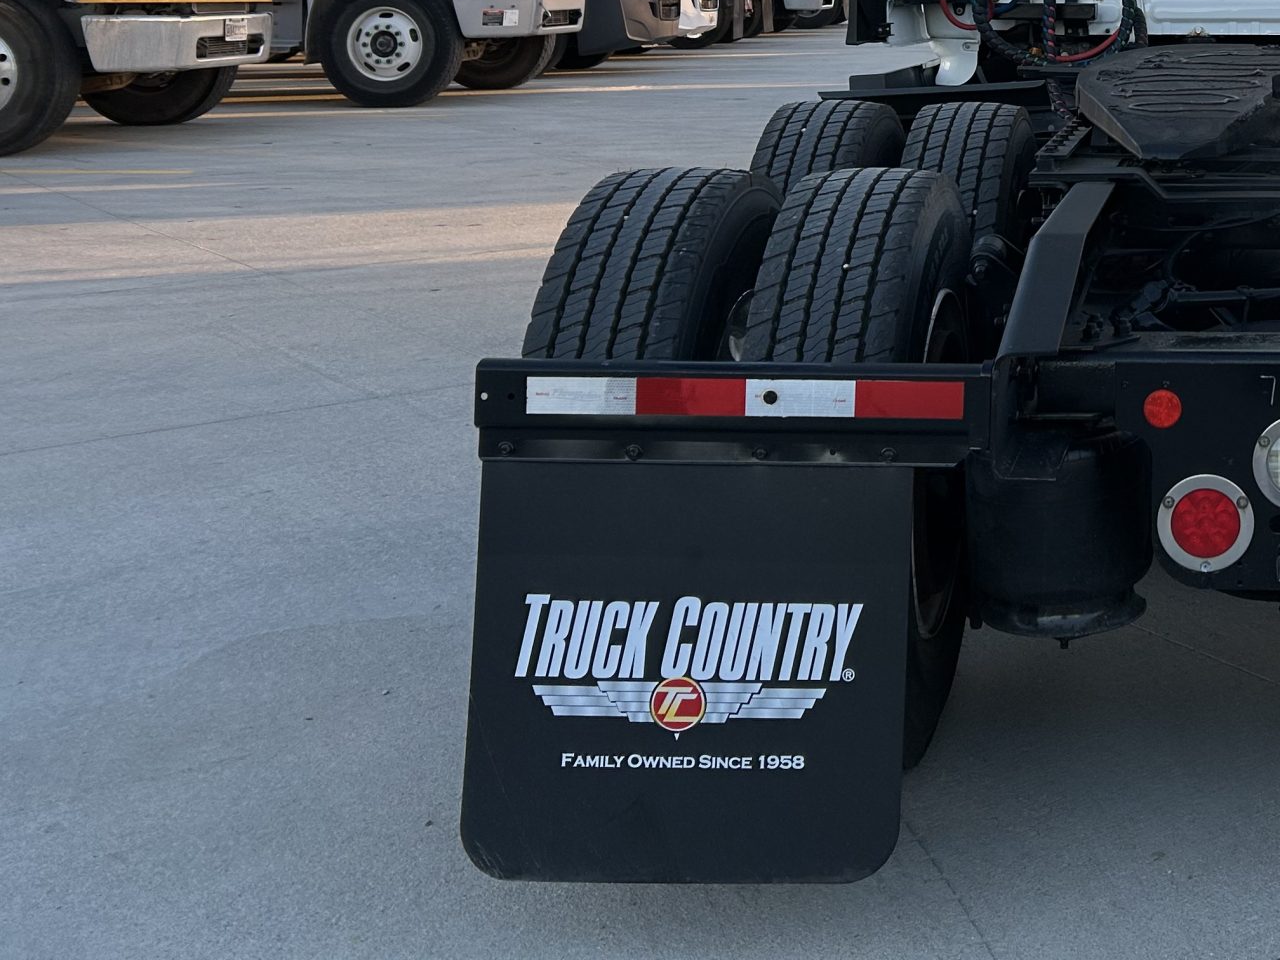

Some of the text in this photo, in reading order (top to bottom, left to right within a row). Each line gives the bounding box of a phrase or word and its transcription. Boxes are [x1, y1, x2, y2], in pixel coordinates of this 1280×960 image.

[514, 593, 660, 679] TRUCK
[561, 752, 805, 770] FAMILY OWNED SINCE 1958
